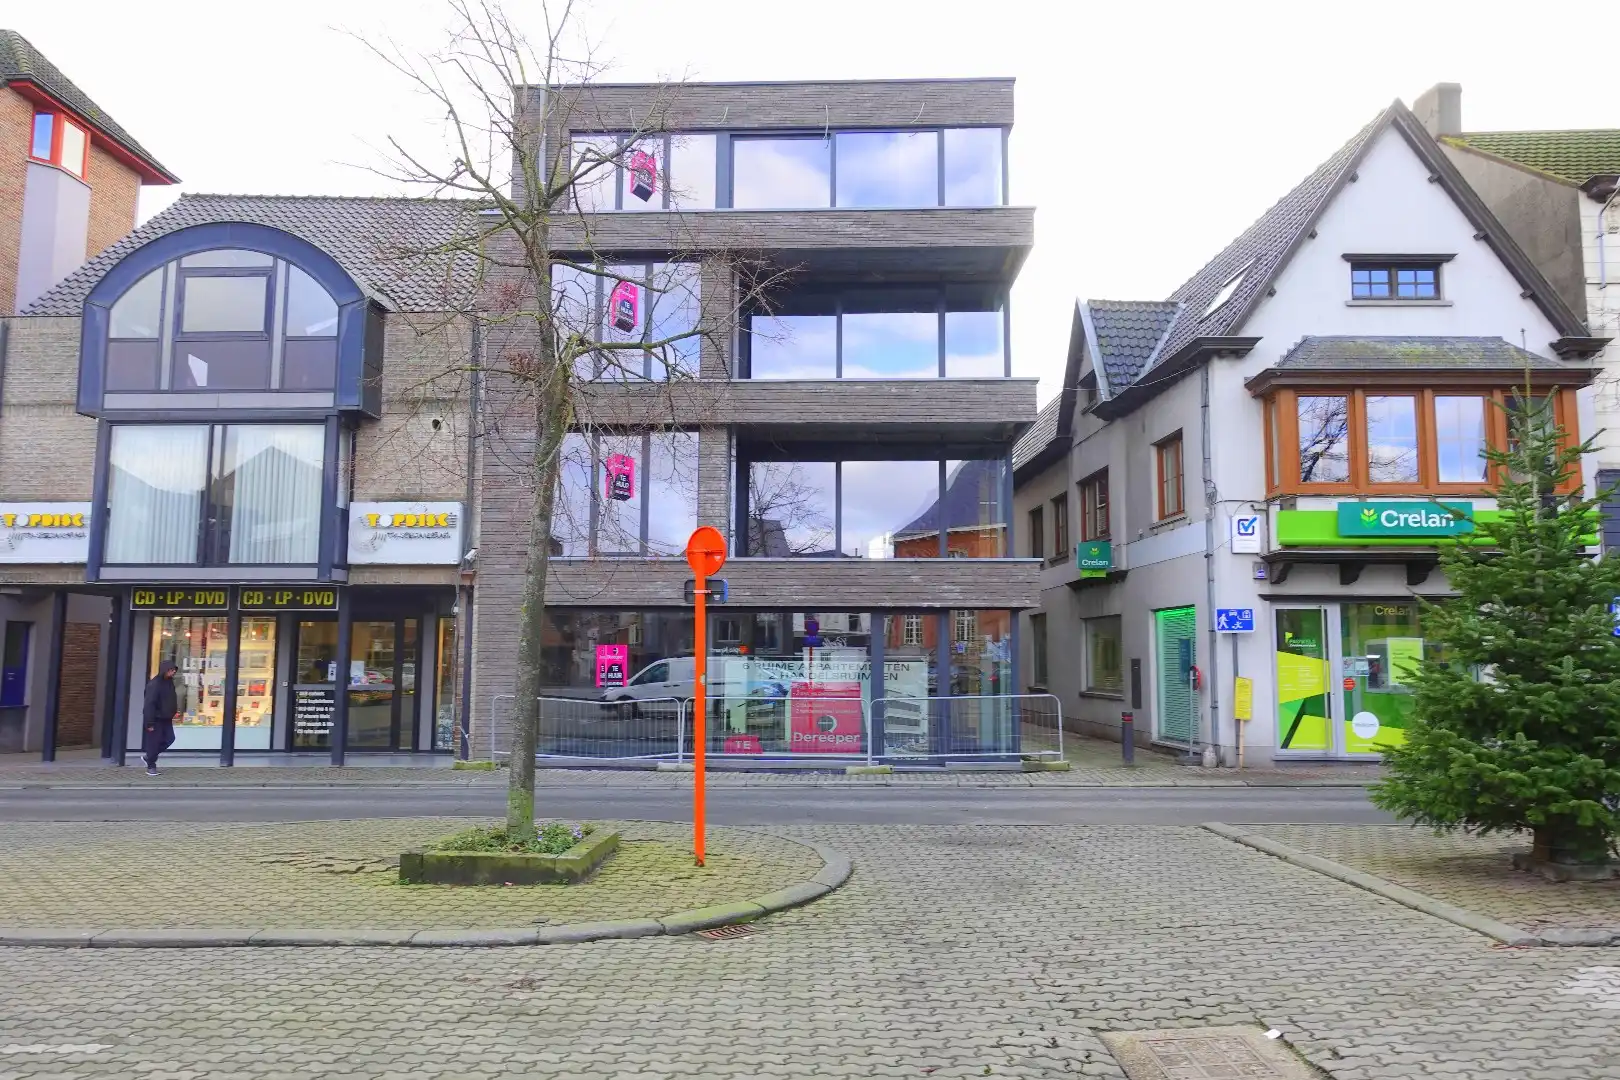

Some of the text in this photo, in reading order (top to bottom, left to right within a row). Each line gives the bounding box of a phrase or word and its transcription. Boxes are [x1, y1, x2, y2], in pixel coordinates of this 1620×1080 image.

[3, 512, 85, 528] TOPDISC
[366, 512, 449, 528] TOPDISC
[1380, 509, 1455, 528] Crelan
[135, 591, 225, 605] CD LP DVD
[243, 591, 334, 605] CD LP DVD
[1374, 604, 1413, 616] Crelan
[742, 662, 911, 673] 6 RUIME APPARTEMTEN
[780, 671, 899, 681] HANDELSRUIMEN
[735, 740, 751, 750] TE
[793, 732, 861, 745] Dereeper
